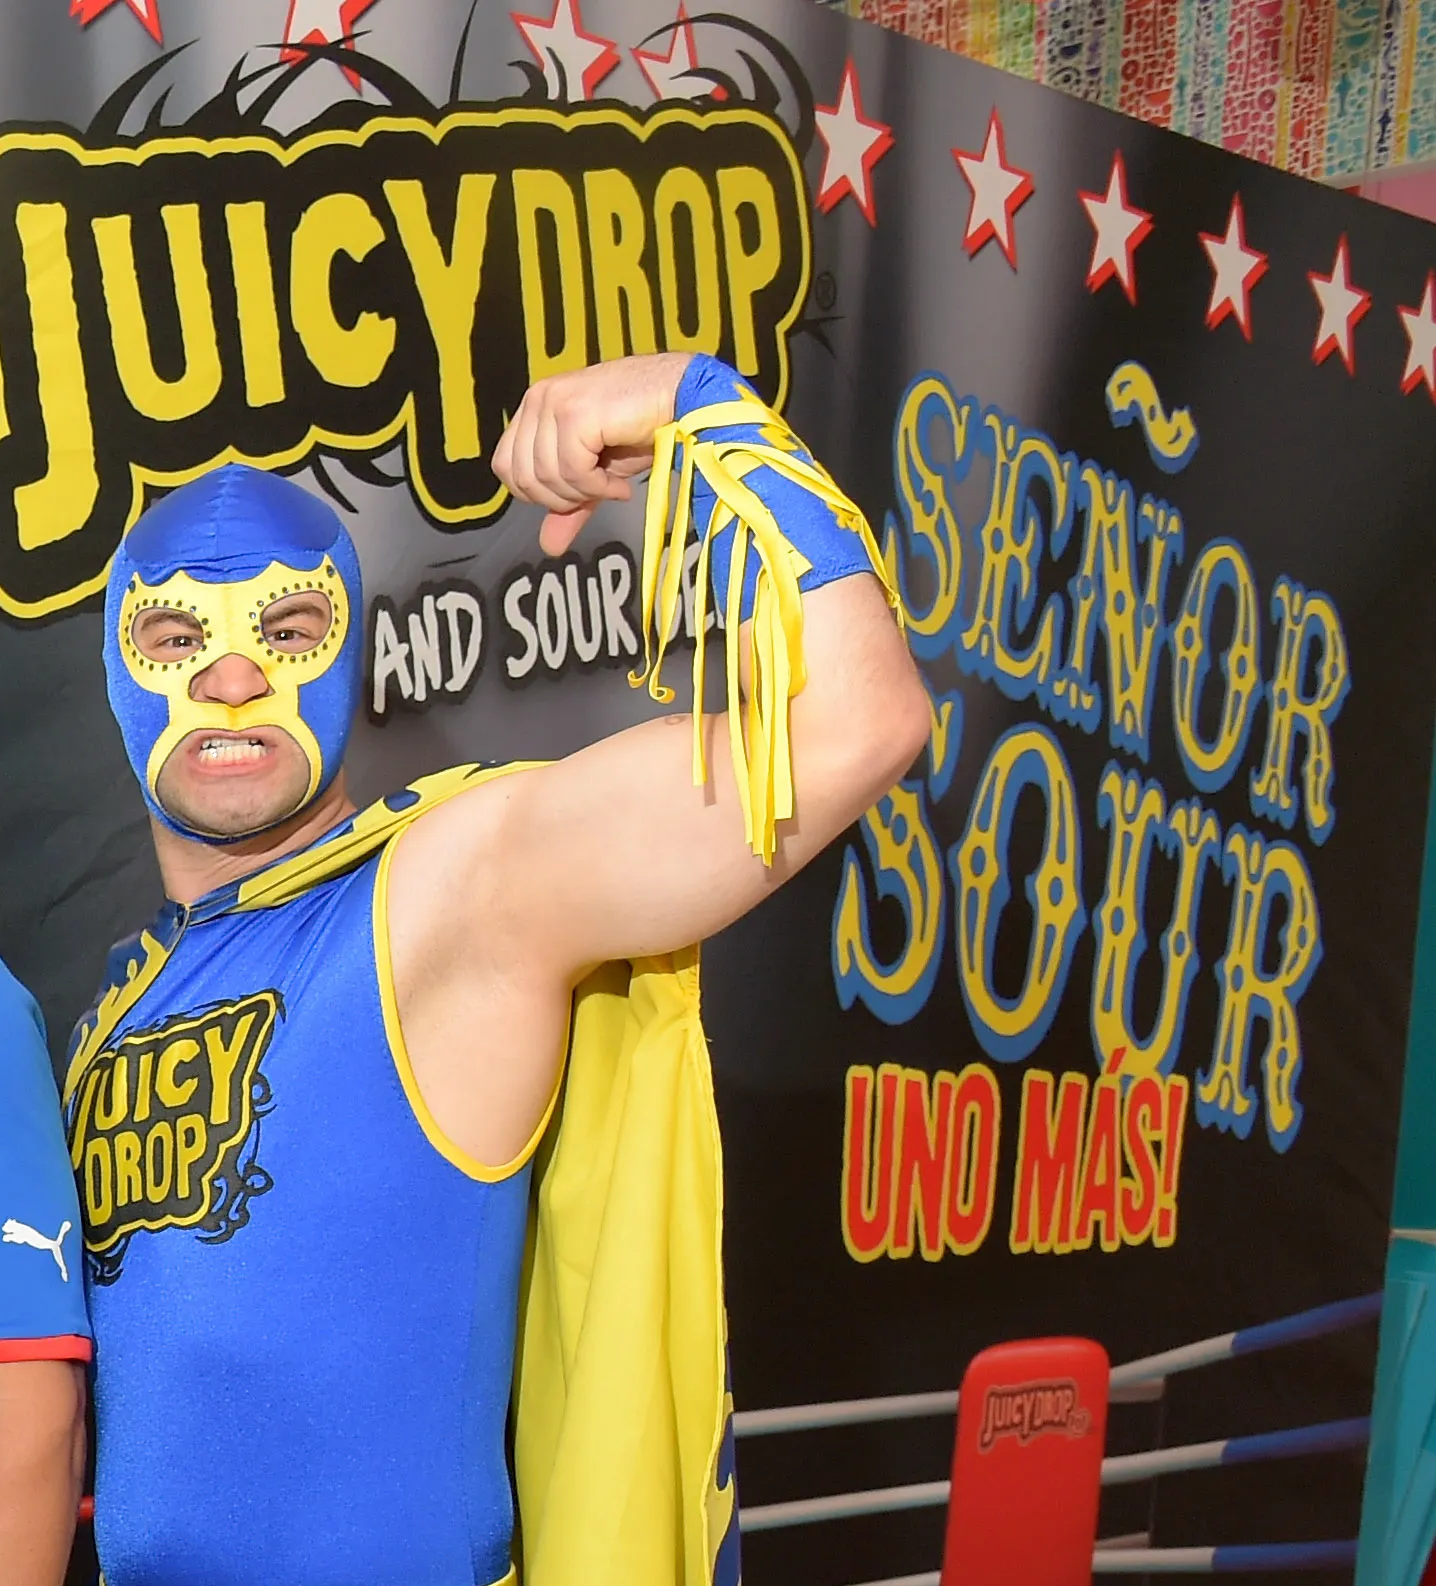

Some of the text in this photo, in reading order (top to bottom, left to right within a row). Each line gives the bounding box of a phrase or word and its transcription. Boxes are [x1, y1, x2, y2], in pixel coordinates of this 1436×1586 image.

[374, 590, 483, 715] AND
[504, 553, 638, 678] SOUR
[885, 360, 1351, 846] SEÑOR
[832, 690, 1324, 1153] SOUR
[72, 1010, 259, 1171] JUICY
[83, 1112, 207, 1227] DROP
[842, 1046, 1188, 1262] UNO MÁS!
